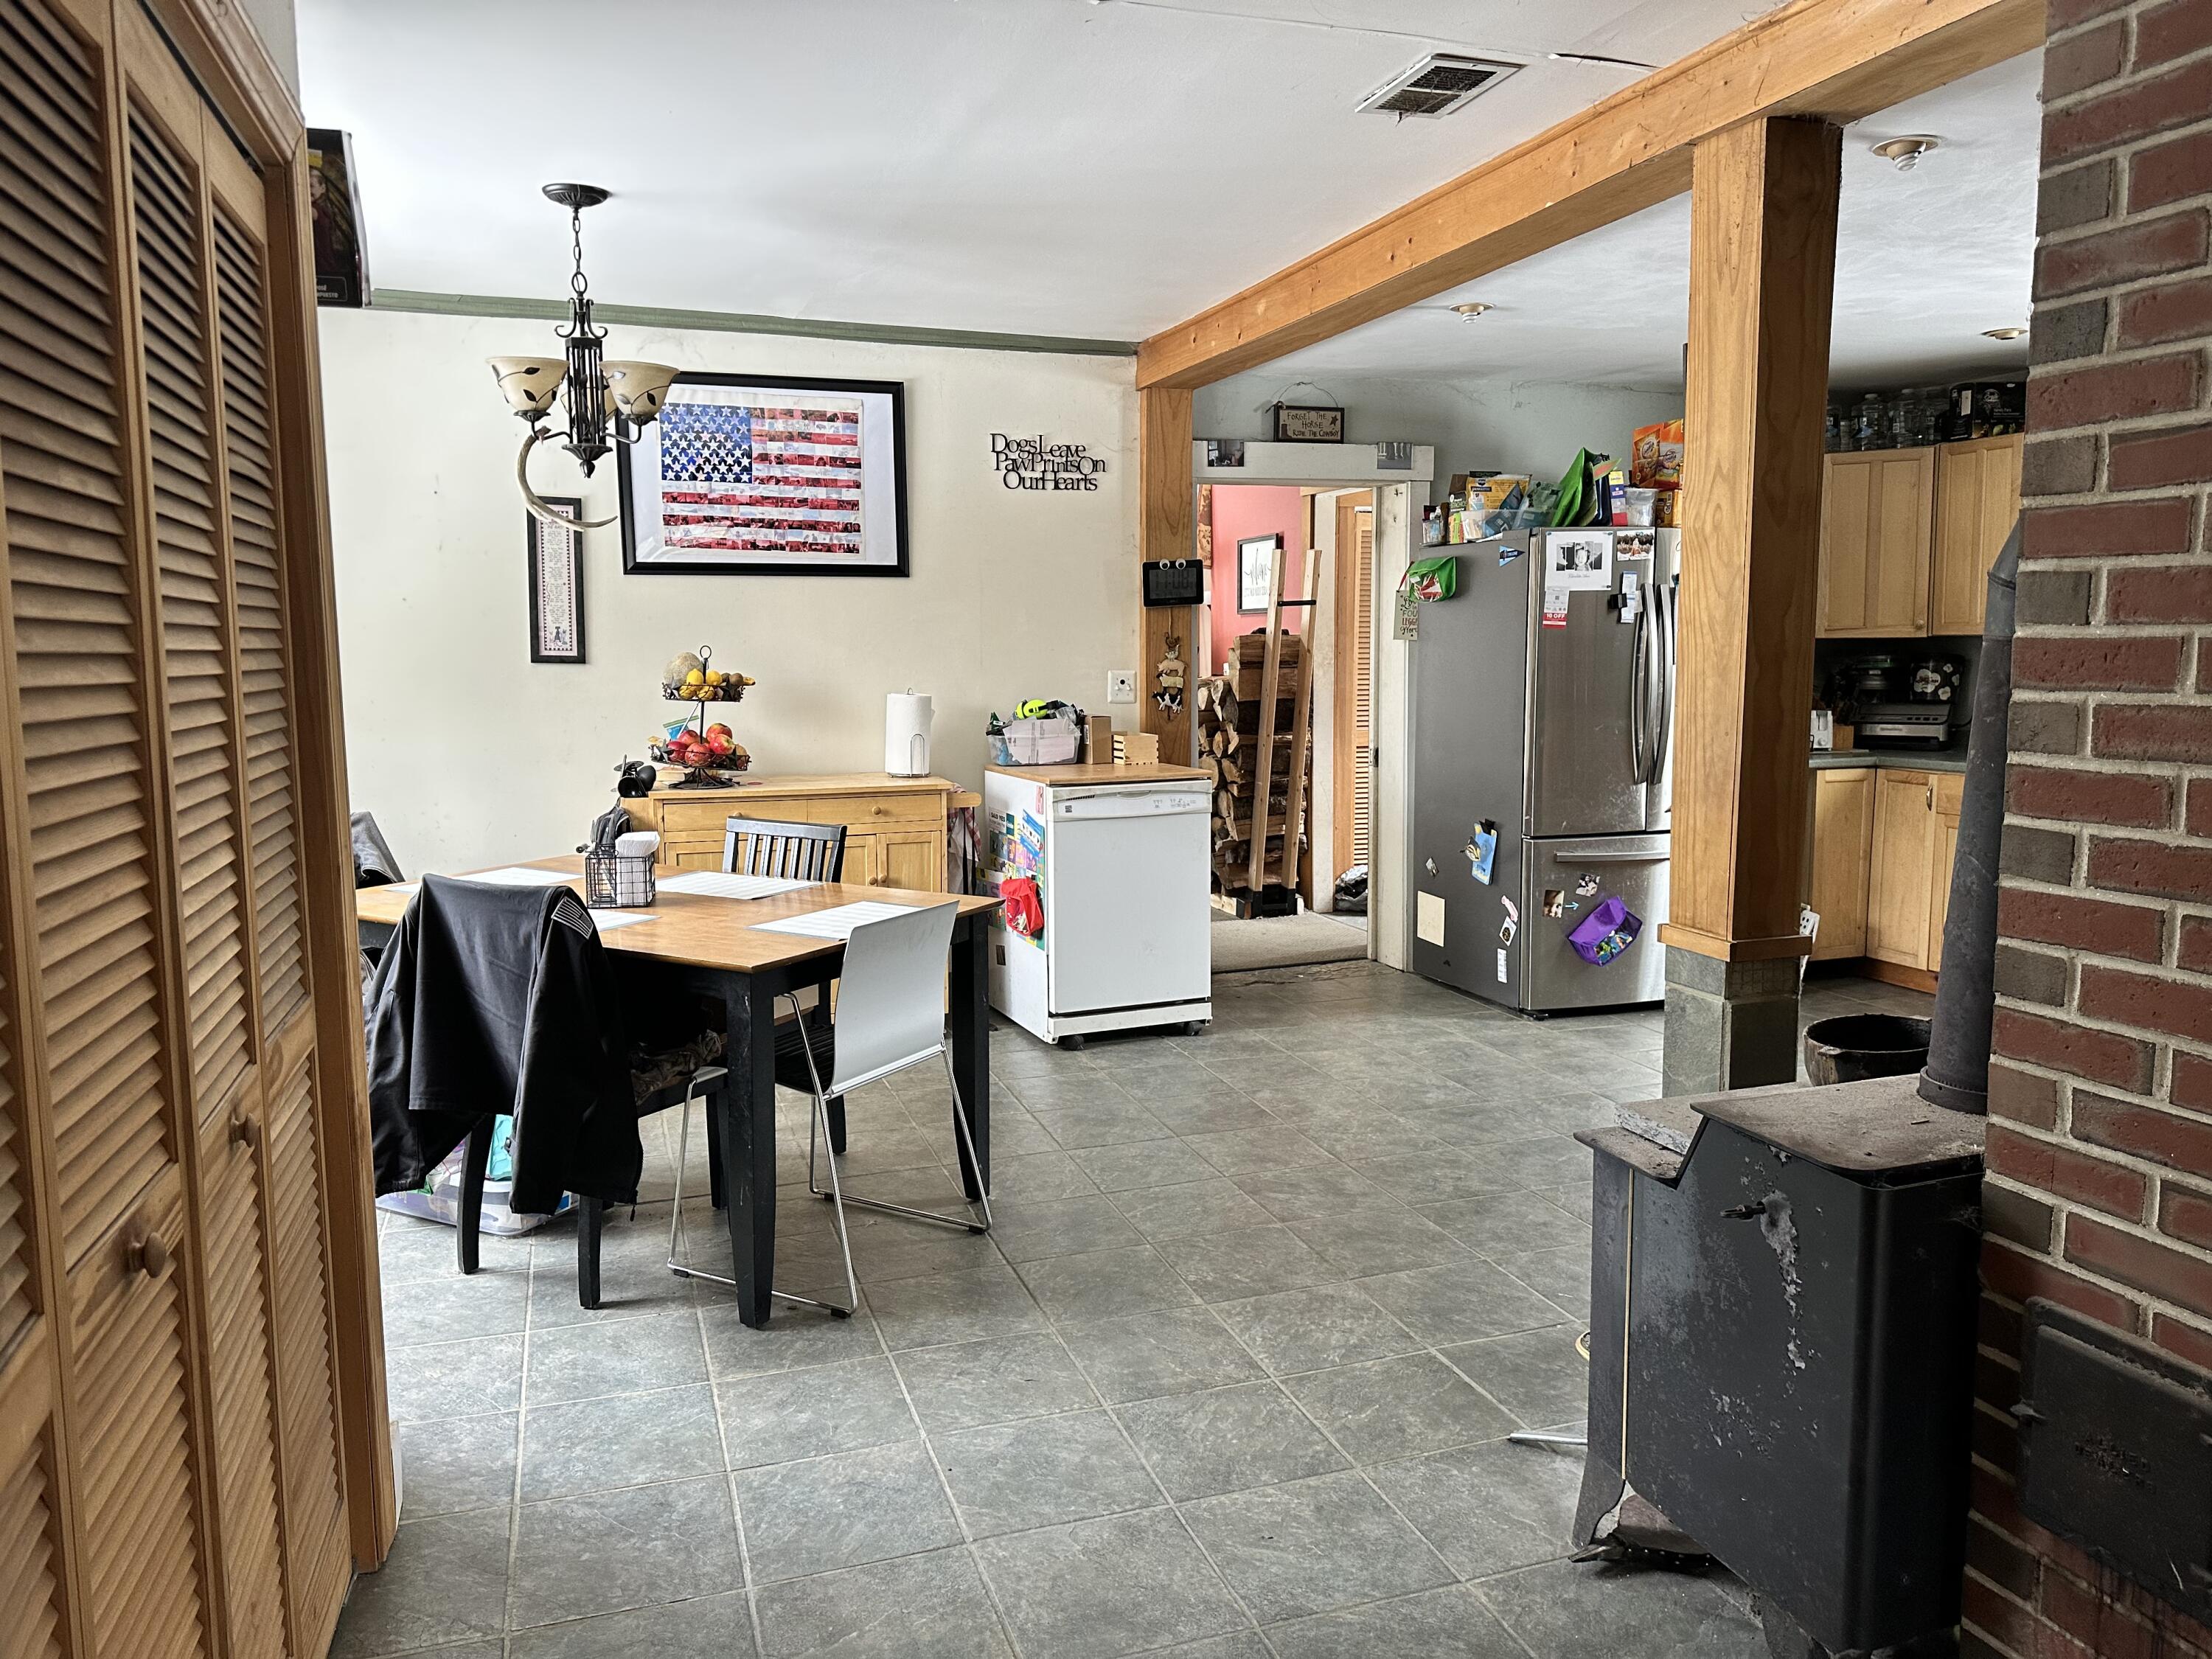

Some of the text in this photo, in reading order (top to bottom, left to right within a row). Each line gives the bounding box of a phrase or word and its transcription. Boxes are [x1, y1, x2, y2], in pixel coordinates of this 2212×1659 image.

[1287, 411, 1327, 420] FORGET THE
[1301, 421, 1324, 429] HORSE
[1309, 429, 1318, 437] THE
[1318, 429, 1340, 437] COWBOY
